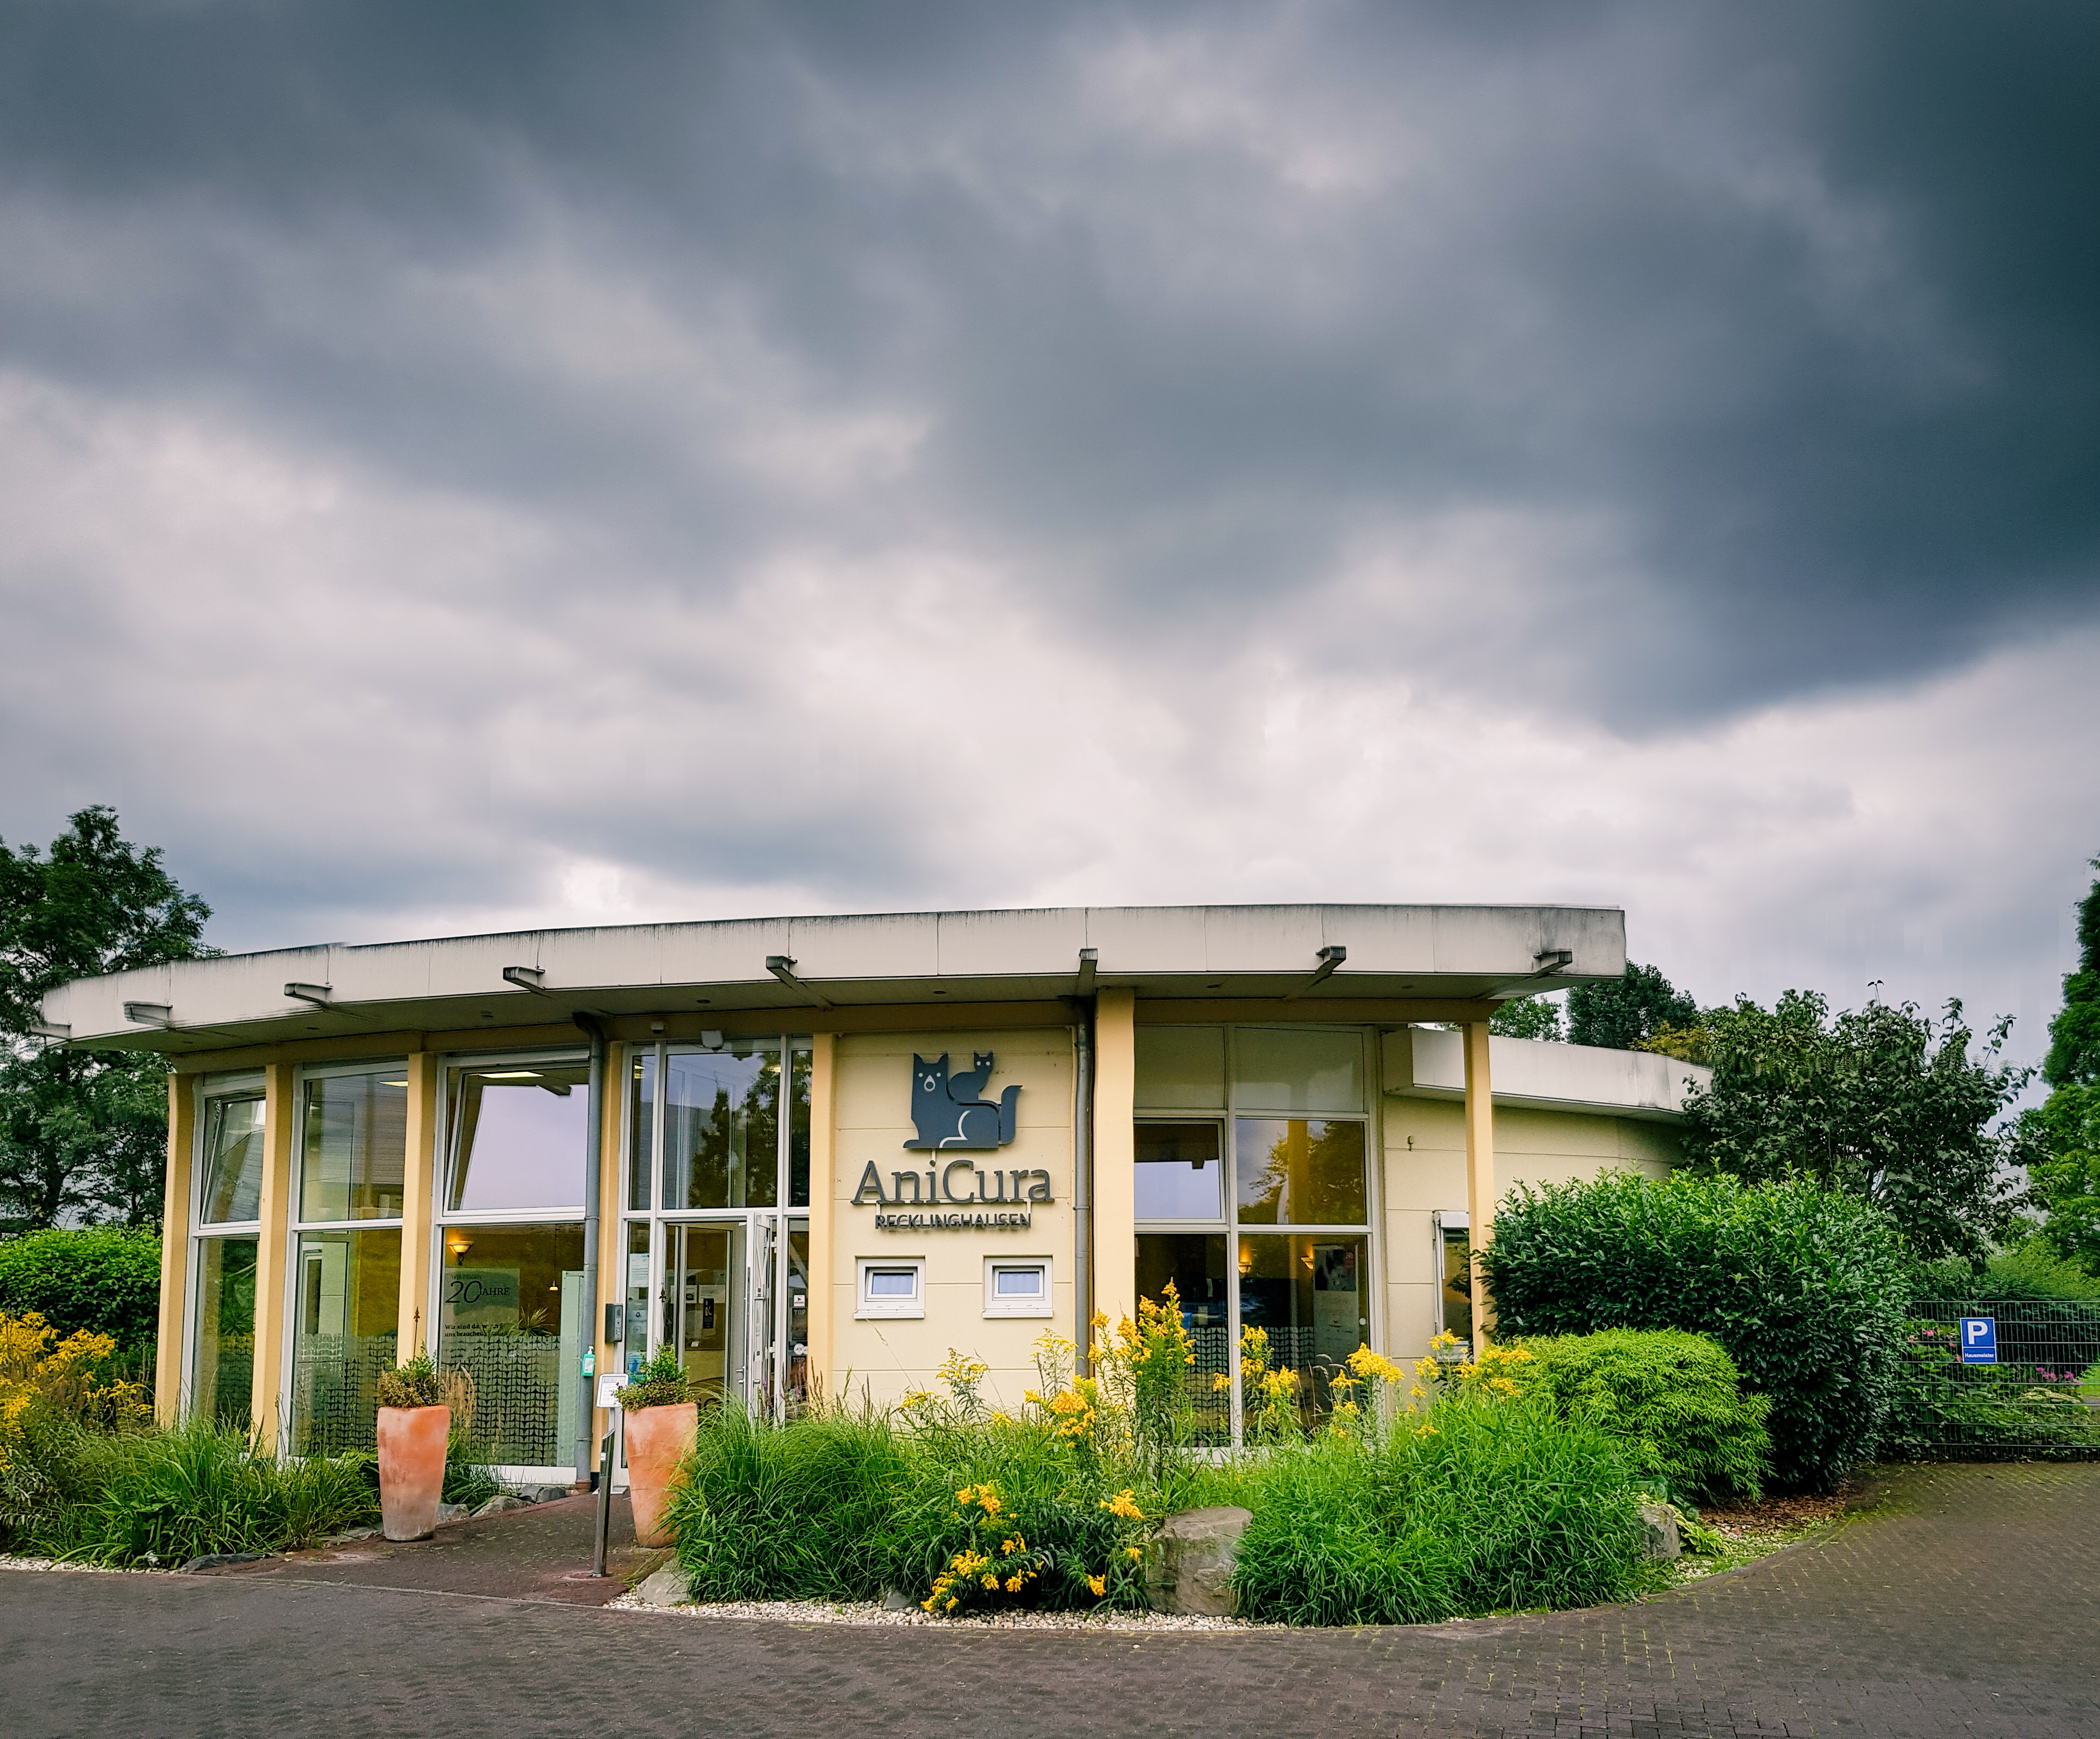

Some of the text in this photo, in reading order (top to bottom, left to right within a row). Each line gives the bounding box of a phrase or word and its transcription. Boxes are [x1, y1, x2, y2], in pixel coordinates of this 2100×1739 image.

[850, 1160, 1055, 1205] AniCura
[875, 1213, 1031, 1229] RECKLINGHAUSEN
[445, 1281, 481, 1303] 20
[1967, 1321, 1988, 1344] P
